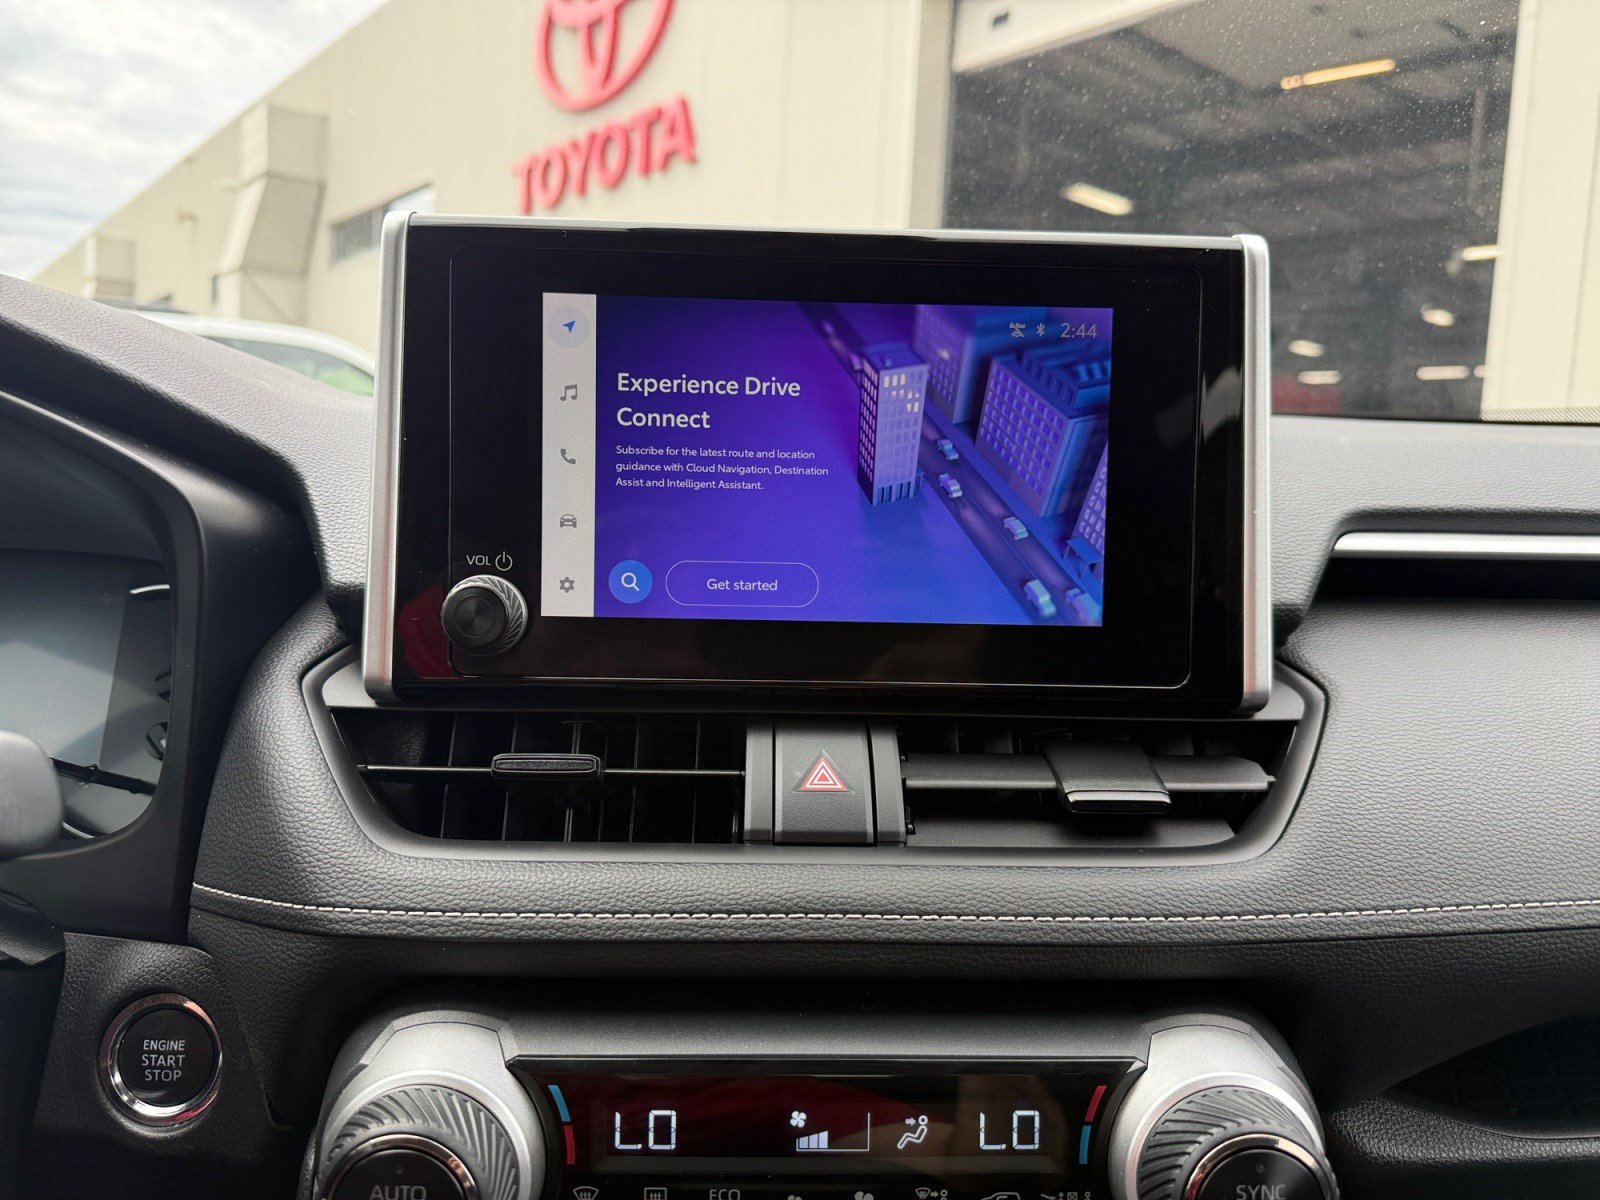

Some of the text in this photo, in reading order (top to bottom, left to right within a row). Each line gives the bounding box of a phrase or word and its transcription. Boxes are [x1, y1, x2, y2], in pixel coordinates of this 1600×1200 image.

[513, 94, 697, 215] TOYOTA
[1060, 322, 1098, 340] 2:44
[617, 372, 801, 396] Experience Drive
[616, 407, 711, 429] Connect
[616, 445, 815, 459] Subscribe for the latest route and location
[616, 461, 829, 476] guidance with Cloud Navigation, Destination
[616, 478, 764, 491] Assist and Intelligent Assistant.
[466, 555, 491, 566] VOL
[707, 578, 778, 592] Get started
[143, 1039, 186, 1051] ENGINE
[141, 1054, 186, 1066] START
[144, 1069, 182, 1081] STOP
[614, 1110, 678, 1151] LO
[978, 1110, 1041, 1151] LO
[371, 1185, 427, 1200] AUTO
[709, 1189, 741, 1200] ECO
[1235, 1184, 1287, 1200] SYNC
